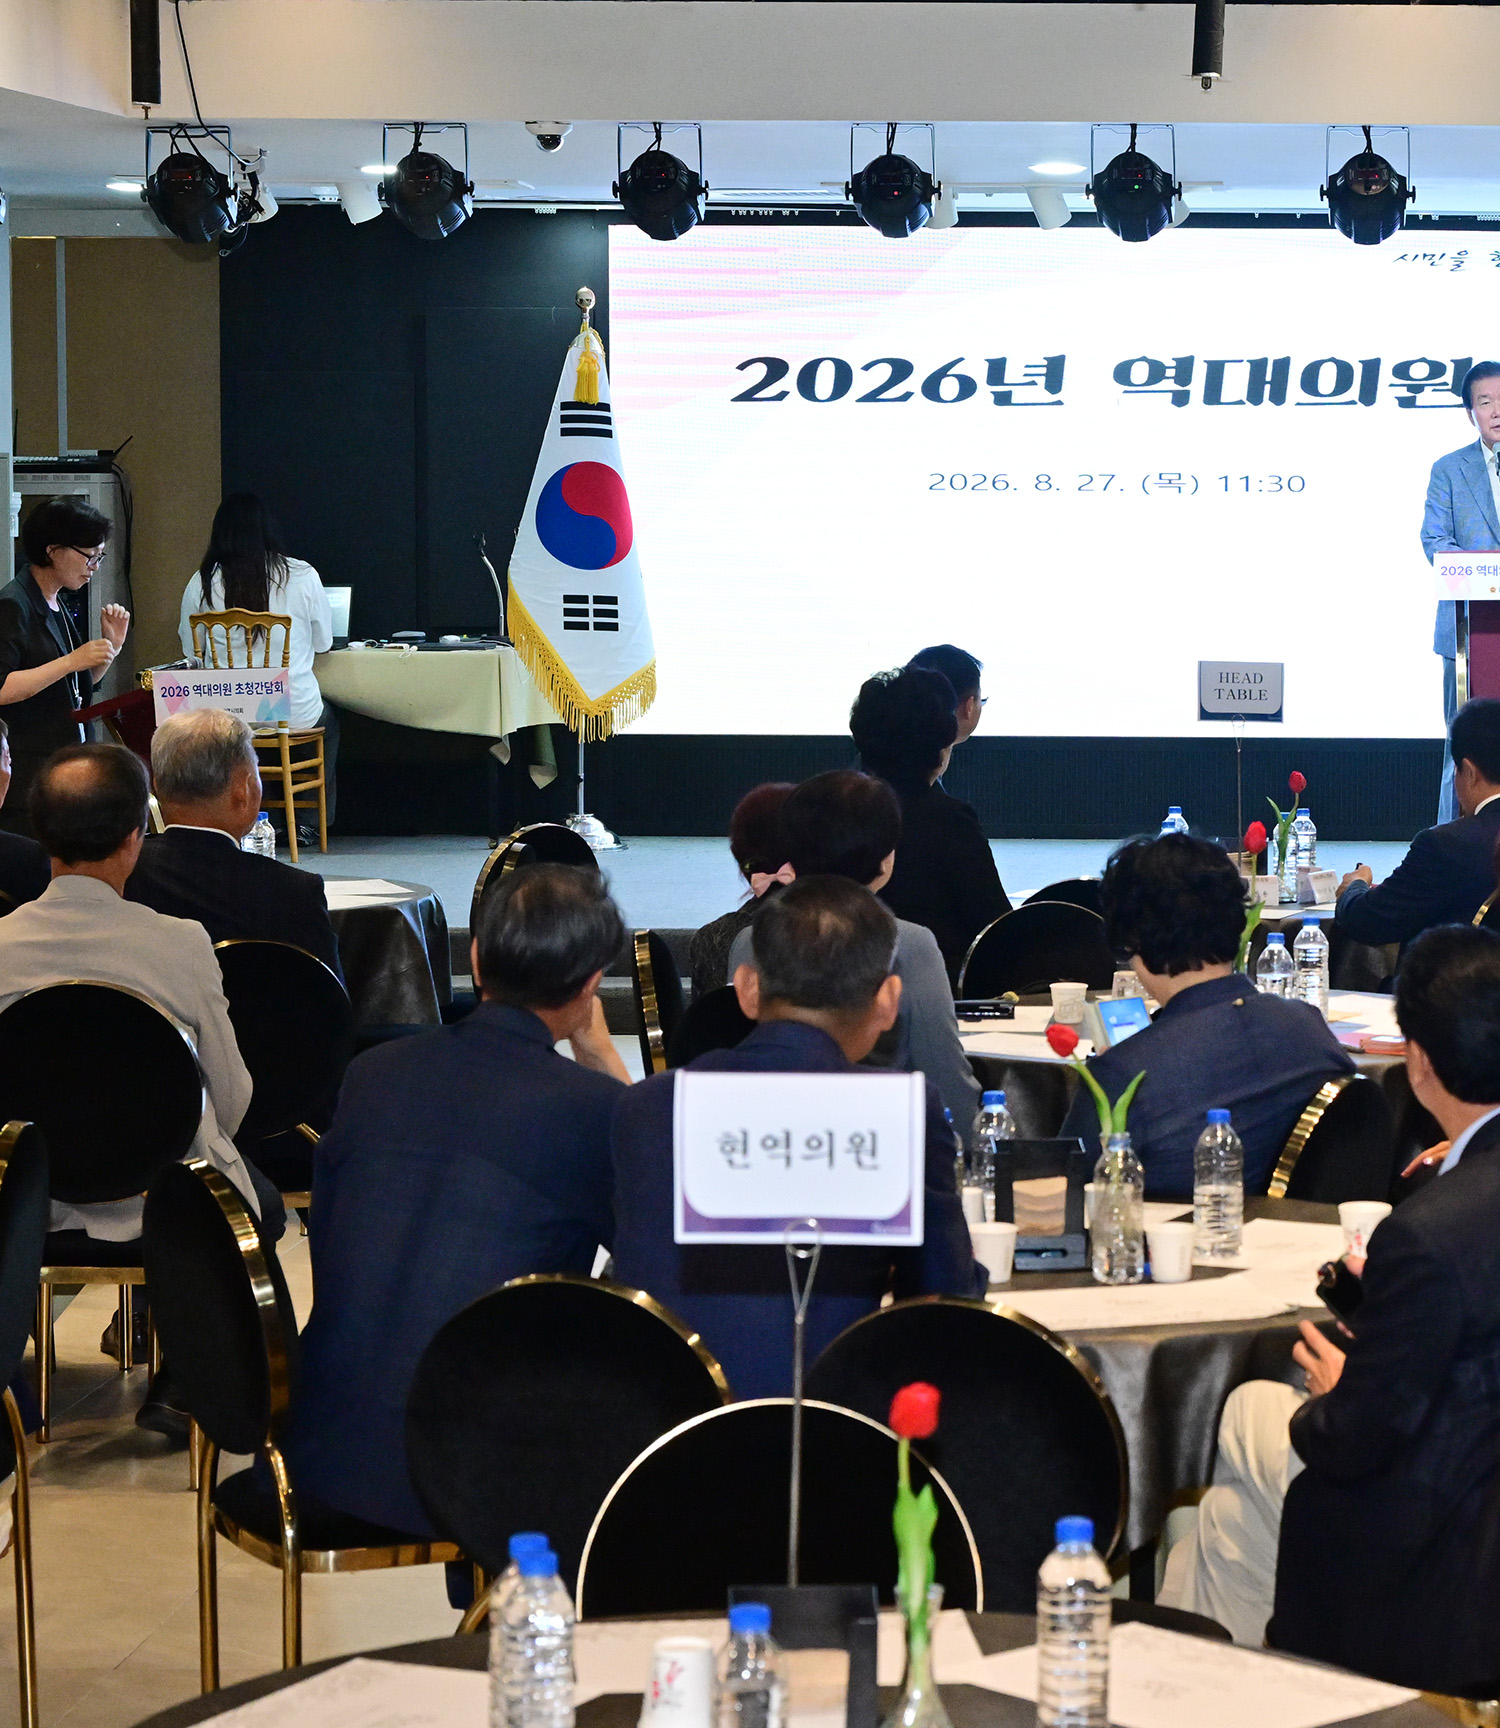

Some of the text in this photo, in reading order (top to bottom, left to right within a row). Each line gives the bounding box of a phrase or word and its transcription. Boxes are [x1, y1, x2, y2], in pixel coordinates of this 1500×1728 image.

[1392, 250, 1471, 272] 시민을
[732, 354, 1067, 408] 2026년
[1112, 354, 1473, 410] 역대의원
[928, 473, 1018, 492] 2026.
[1034, 474, 1061, 492] 8.
[1077, 474, 1125, 492] 27.
[1141, 472, 1200, 495] (목)
[1218, 475, 1306, 493] 11:30
[1440, 566, 1473, 576] 2026
[1219, 671, 1264, 684] HEAD
[160, 681, 284, 698] 2026 역대의원 초청간담회
[1214, 688, 1269, 701] TABLE
[716, 1129, 880, 1171] 현역의원
